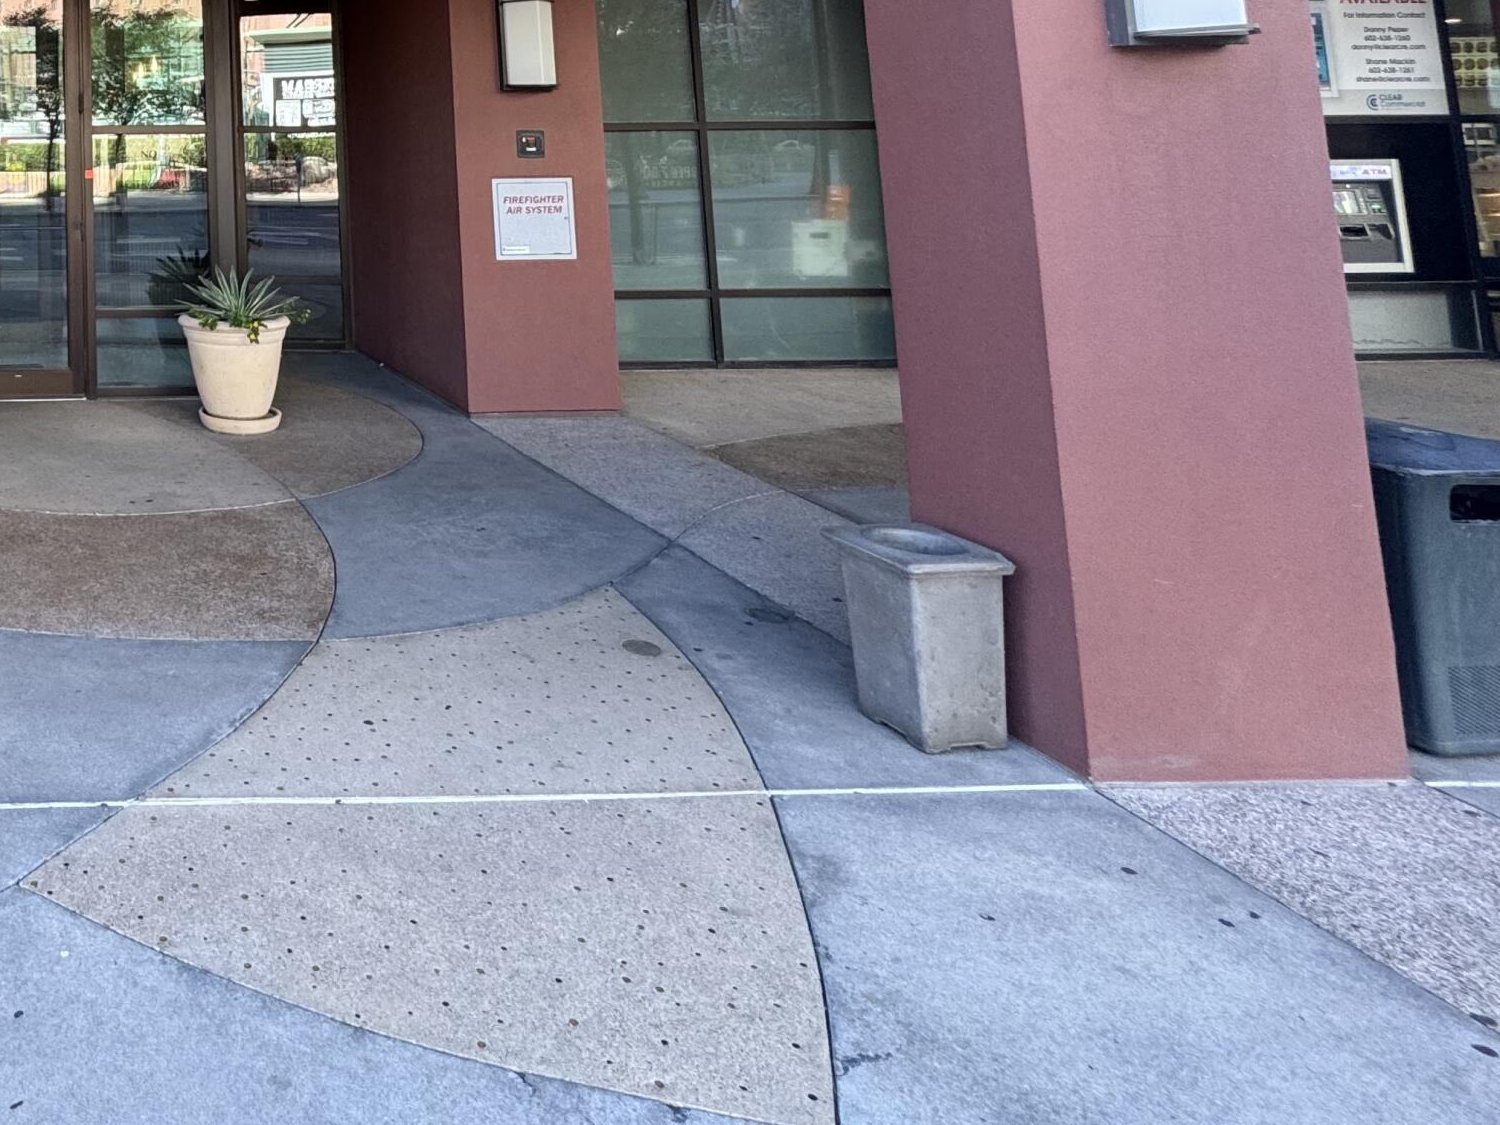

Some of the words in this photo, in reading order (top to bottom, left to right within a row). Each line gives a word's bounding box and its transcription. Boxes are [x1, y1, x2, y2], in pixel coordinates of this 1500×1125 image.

[503, 195, 564, 205] FIREFIGHTER
[506, 206, 522, 214] AIR
[525, 205, 563, 214] SYSTEM
